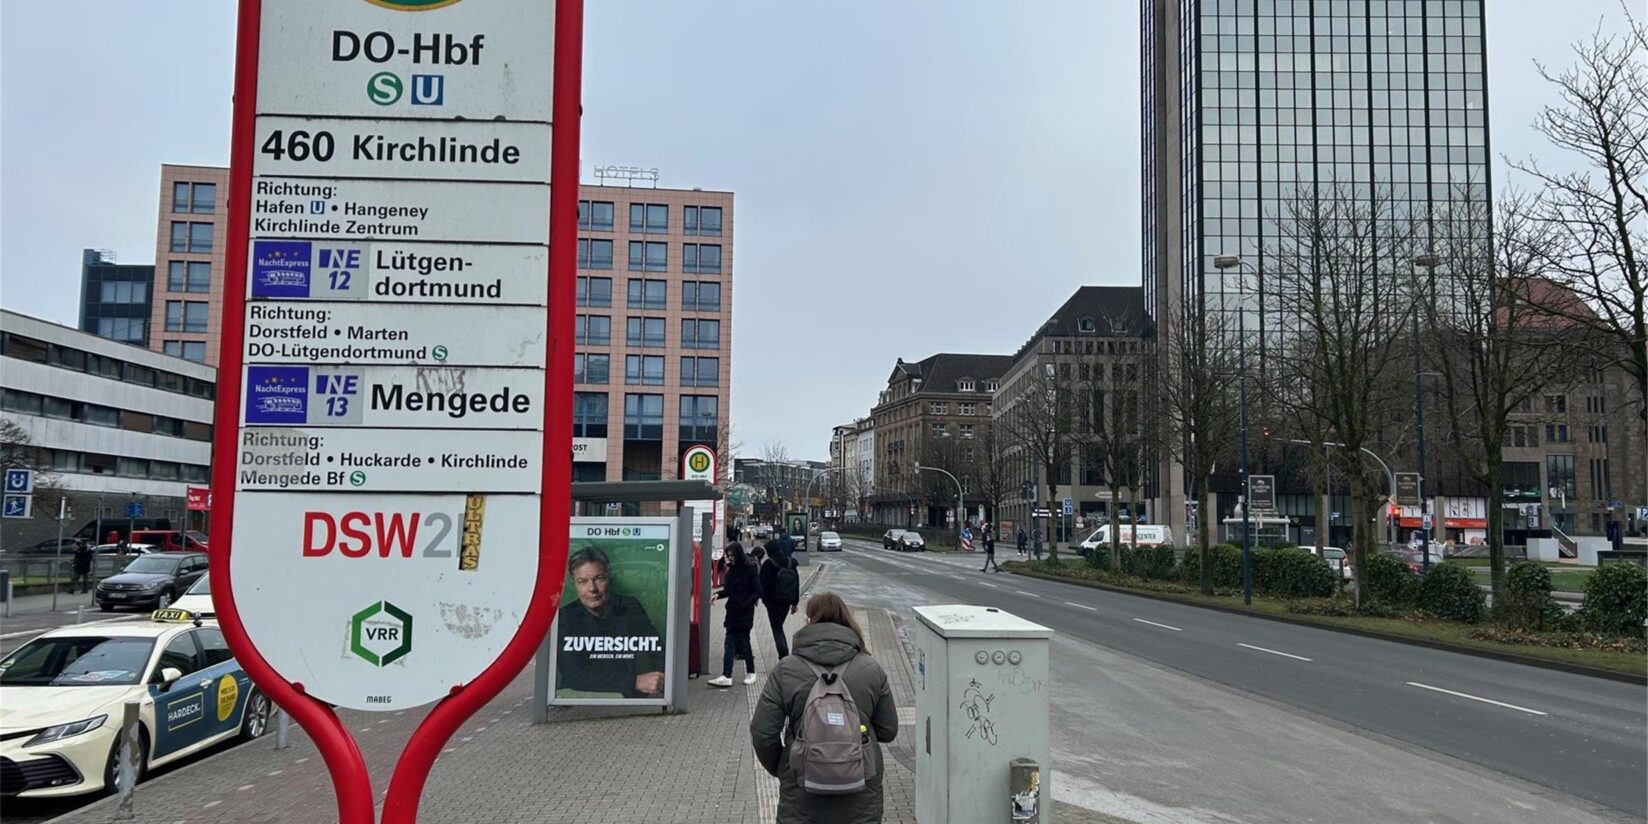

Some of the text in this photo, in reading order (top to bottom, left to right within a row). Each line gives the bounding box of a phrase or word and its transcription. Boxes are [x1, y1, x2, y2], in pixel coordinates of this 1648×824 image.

[332, 30, 485, 66] DO-Hbf
[261, 130, 520, 165] 460 Kirchlinde
[594, 165, 660, 181] HOTELS
[256, 181, 338, 199] Richtung:
[255, 200, 304, 214] Hafen
[344, 202, 429, 220] Hangeney
[254, 218, 419, 236] Kirchlinde Zentrum
[258, 258, 309, 268] NachtExpress
[376, 250, 473, 275] Lütgen-
[328, 271, 351, 290] 12
[374, 277, 502, 299] dortmund
[250, 305, 332, 322] Richtung:
[249, 324, 409, 341] Dorstfeld Marten
[248, 342, 426, 361] DO-Lütgendortmund
[255, 384, 306, 394] NachtExpress
[326, 397, 348, 416] 13
[371, 384, 531, 418] Mengede
[242, 432, 324, 450] Richtung:
[241, 451, 528, 469] Dorstfeld Huckarde Kirchlinde
[240, 471, 321, 489] Mengede
[327, 472, 345, 486] Bf
[587, 528, 601, 536] DO
[604, 527, 621, 536] Hbf
[157, 611, 180, 619] TAXI
[366, 628, 398, 640] VRR
[563, 636, 662, 651] ZUVERSICHT.
[366, 696, 392, 704] MABEG
